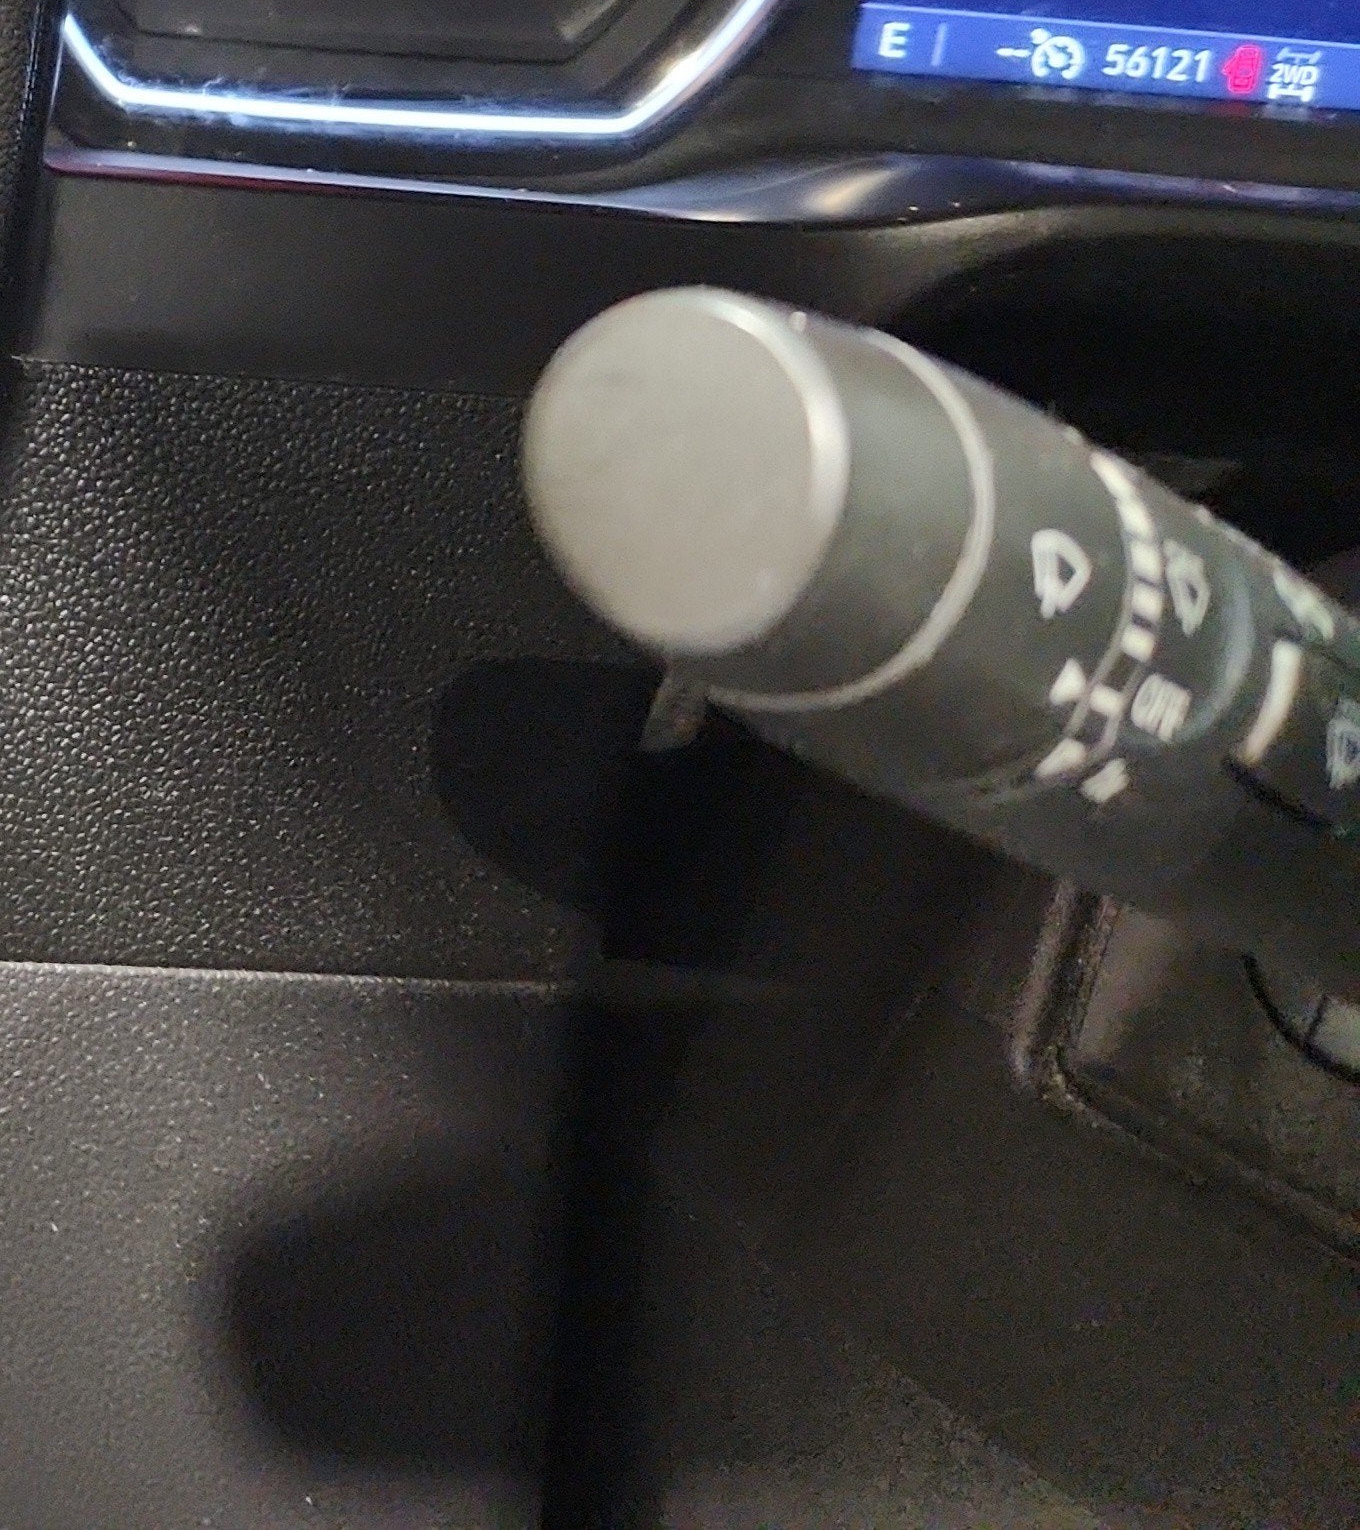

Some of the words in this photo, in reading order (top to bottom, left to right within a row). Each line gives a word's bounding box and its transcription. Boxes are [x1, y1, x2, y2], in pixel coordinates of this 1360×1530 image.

[880, 23, 911, 58] E
[1102, 44, 1212, 83] 56121
[1269, 63, 1319, 85] 2WD
